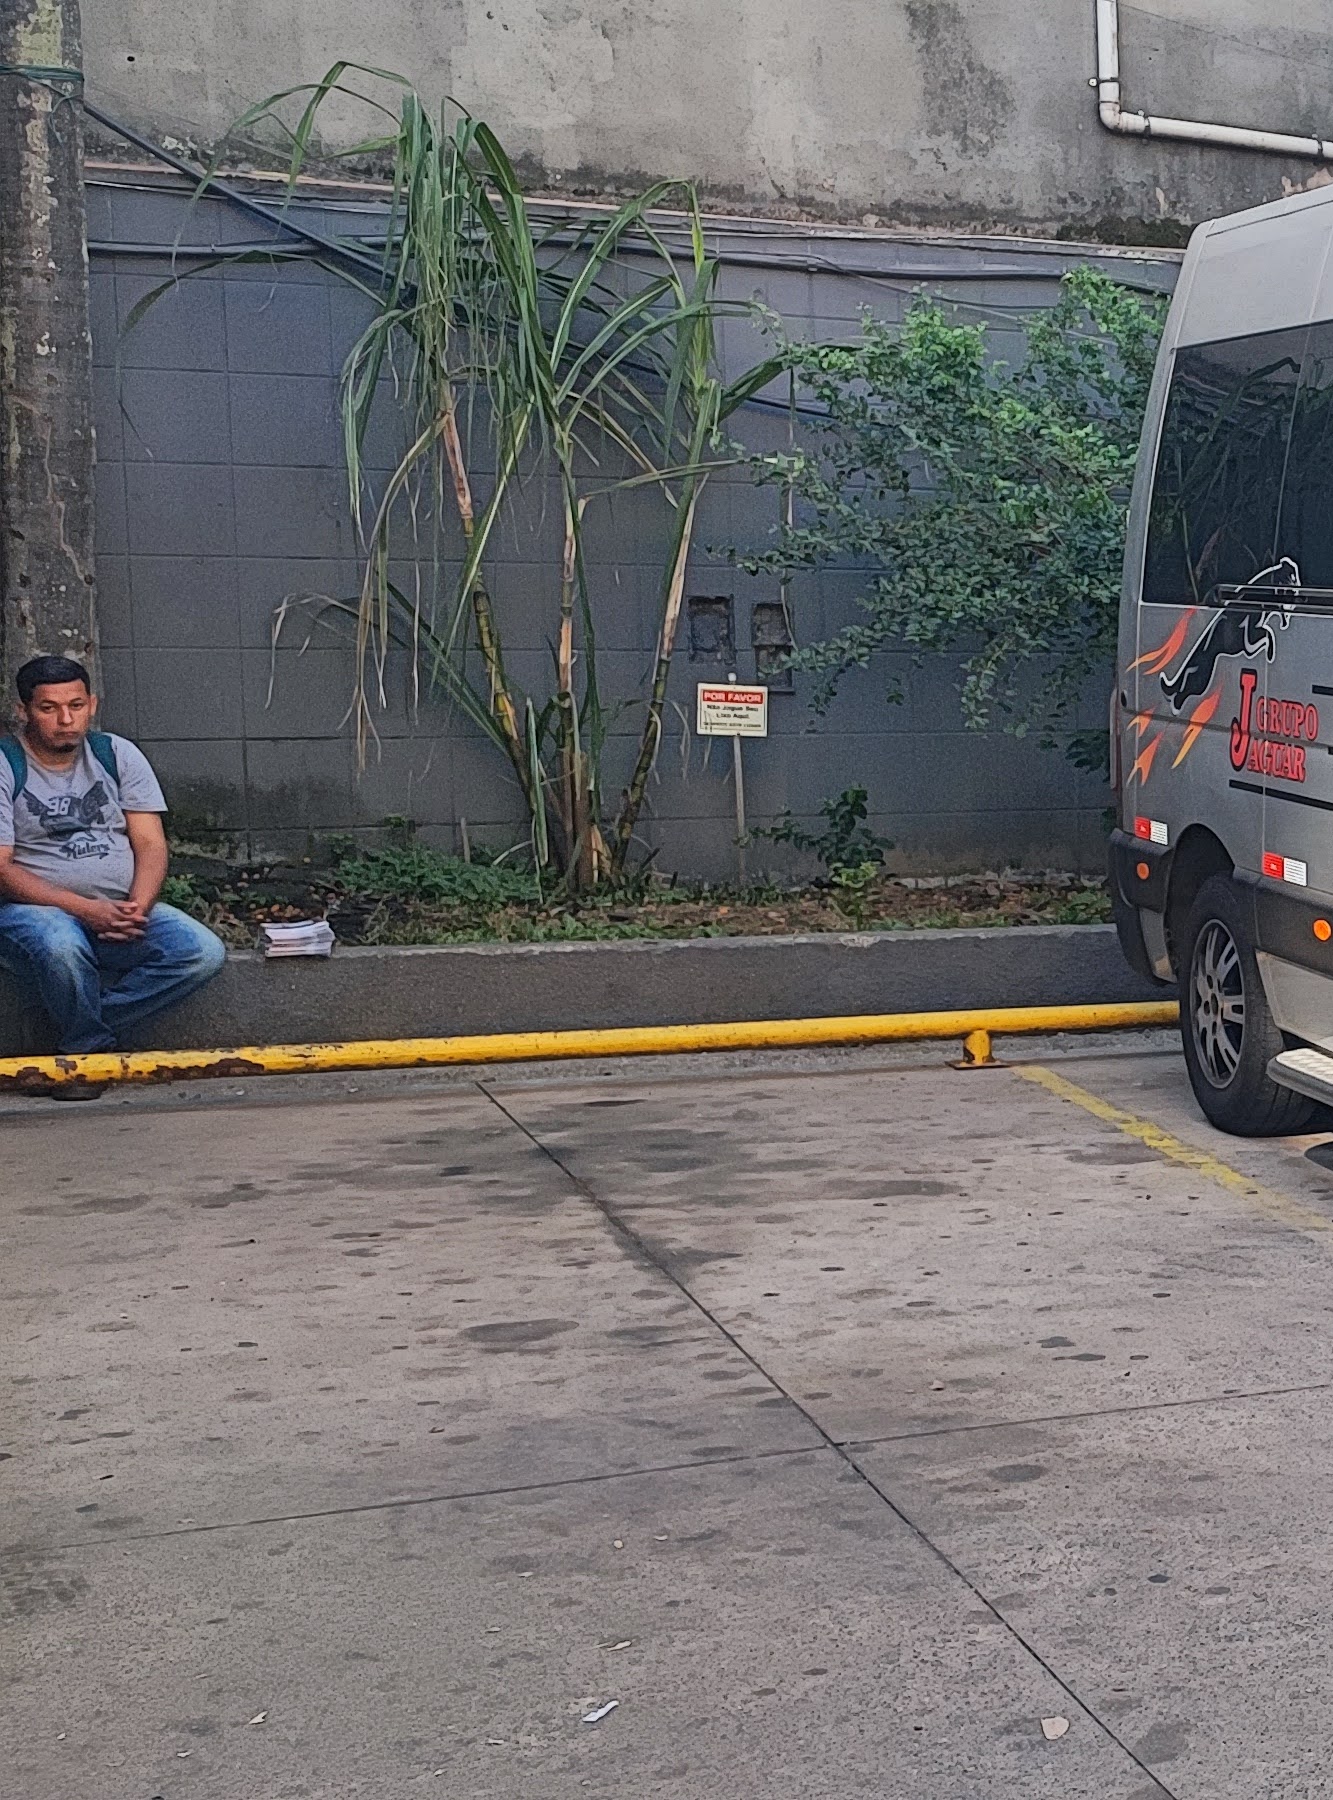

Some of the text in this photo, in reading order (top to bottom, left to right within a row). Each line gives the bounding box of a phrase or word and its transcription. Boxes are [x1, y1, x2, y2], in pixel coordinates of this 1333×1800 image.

[704, 692, 761, 702] POR FAVOR
[1230, 667, 1306, 783] JAGUAR
[1256, 696, 1319, 741] GRUPO
[47, 797, 71, 816] 98
